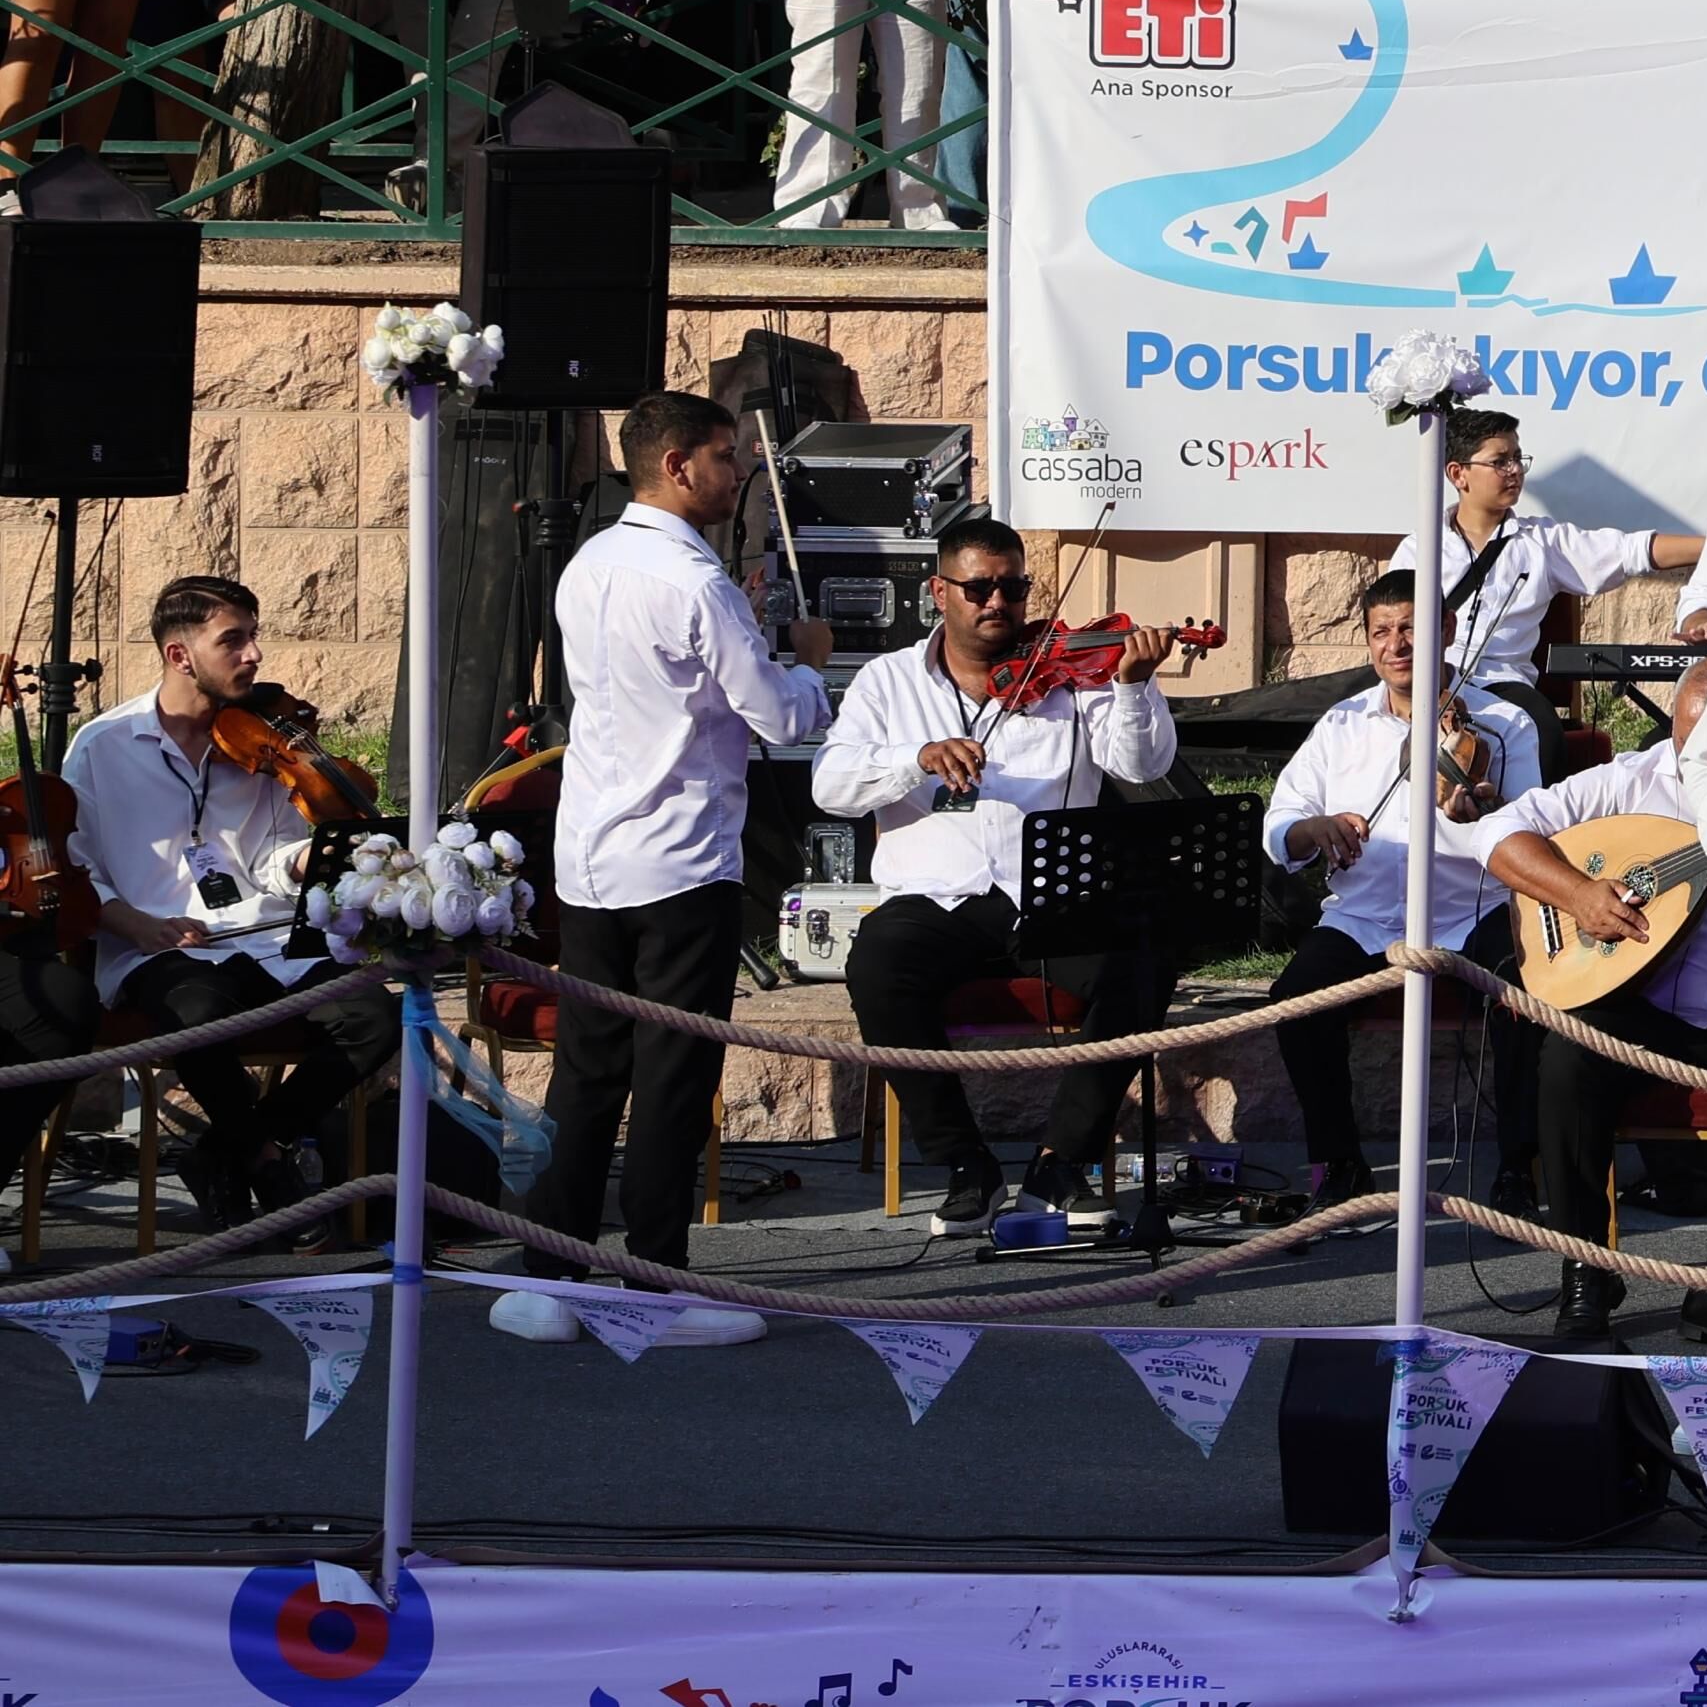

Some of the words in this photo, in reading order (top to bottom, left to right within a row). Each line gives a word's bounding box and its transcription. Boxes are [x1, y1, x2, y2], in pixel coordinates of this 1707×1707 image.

[1091, 79, 1136, 97] Ana
[1139, 78, 1234, 102] Sponsor
[1126, 331, 1394, 395] Porsuk
[1021, 451, 1143, 484] cassaba
[1180, 427, 1330, 482] espark
[1079, 483, 1143, 501] modern
[1406, 1392, 1470, 1414] PORSUK
[1094, 1640, 1184, 1671] ULUSLARARASI
